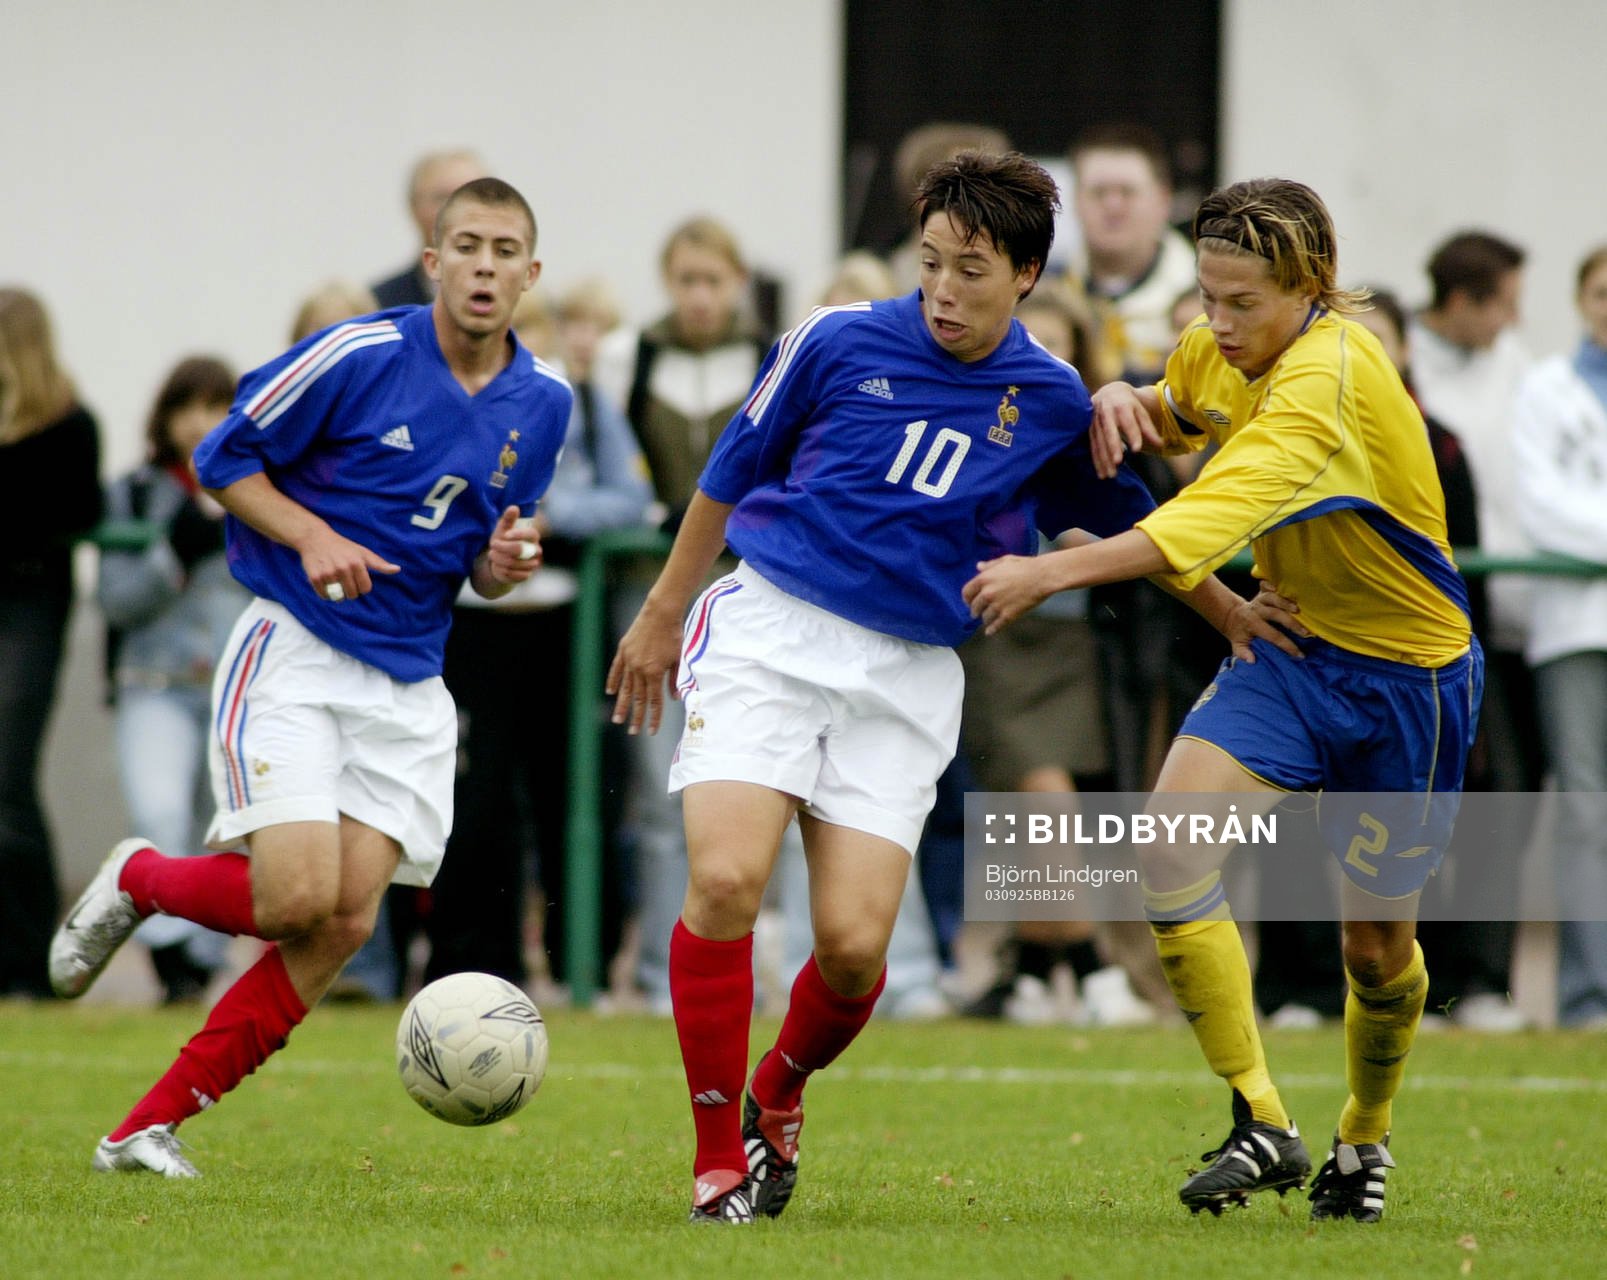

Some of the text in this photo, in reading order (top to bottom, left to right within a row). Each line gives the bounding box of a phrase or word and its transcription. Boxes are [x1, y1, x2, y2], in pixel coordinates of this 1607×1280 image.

[884, 419, 972, 499] 10
[410, 474, 469, 531] 9
[1344, 812, 1389, 877] 2
